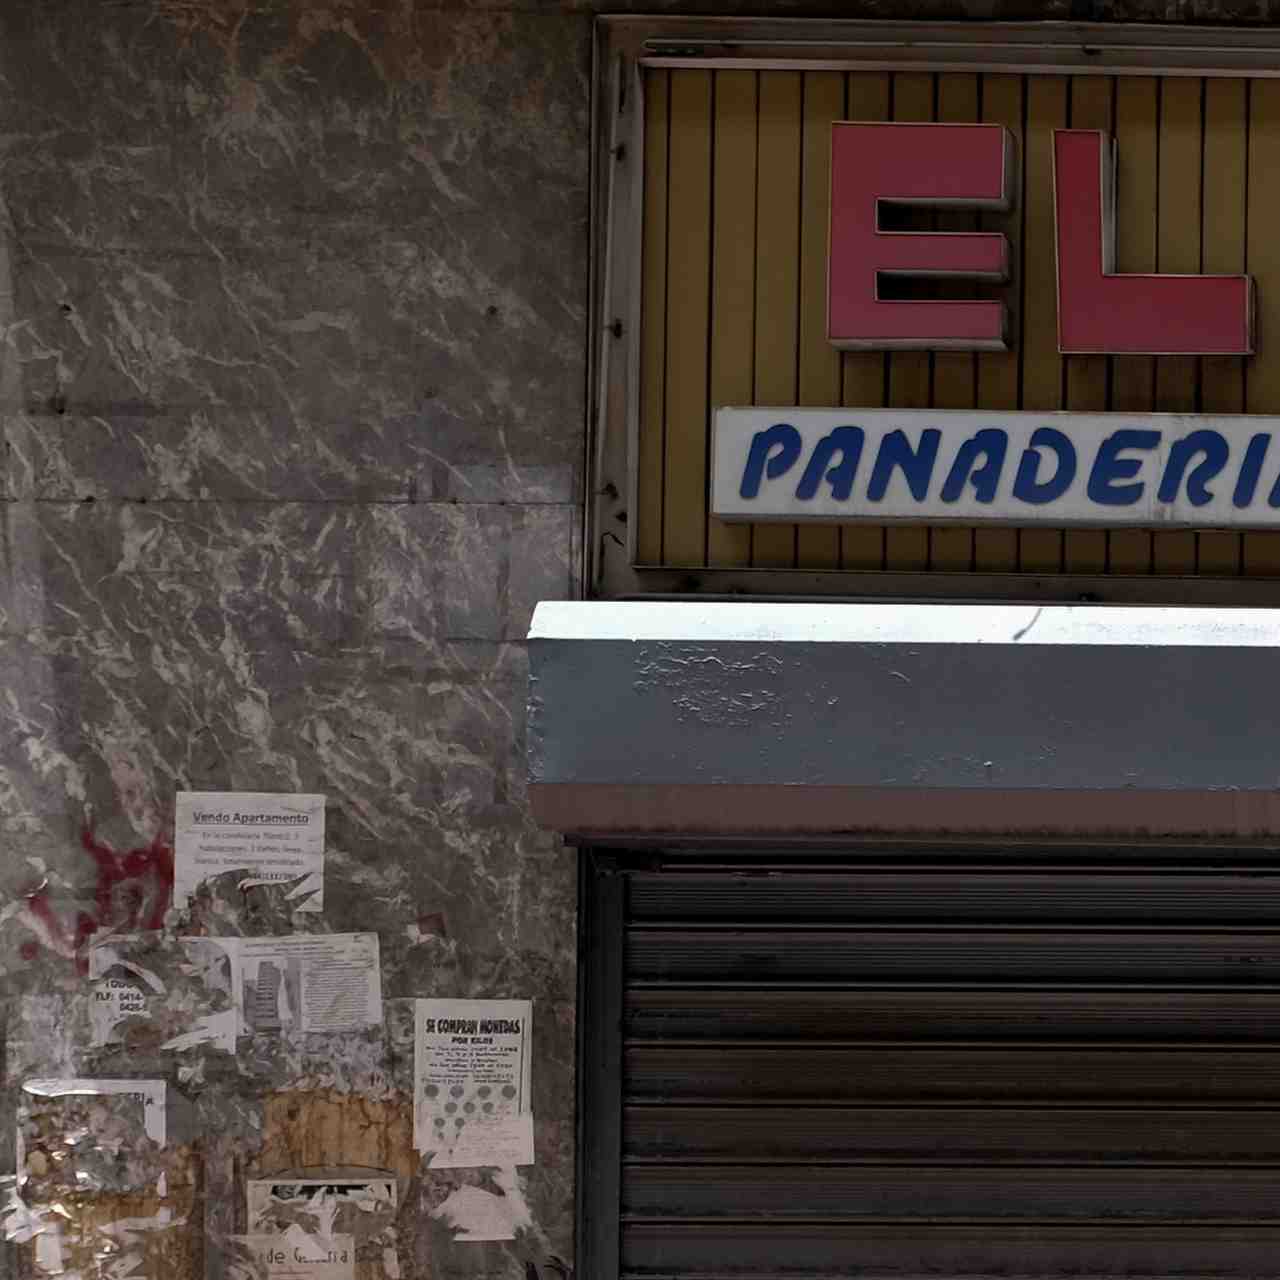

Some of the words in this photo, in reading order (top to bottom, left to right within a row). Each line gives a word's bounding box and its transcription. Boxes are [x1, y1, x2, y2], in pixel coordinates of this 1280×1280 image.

[826, 121, 1256, 356] EL
[193, 811, 230, 823] Vendo
[233, 812, 309, 825] Apartamento
[426, 1018, 436, 1033] SE
[437, 1018, 477, 1035] COMPRAN
[479, 1018, 521, 1035] MONEDAS
